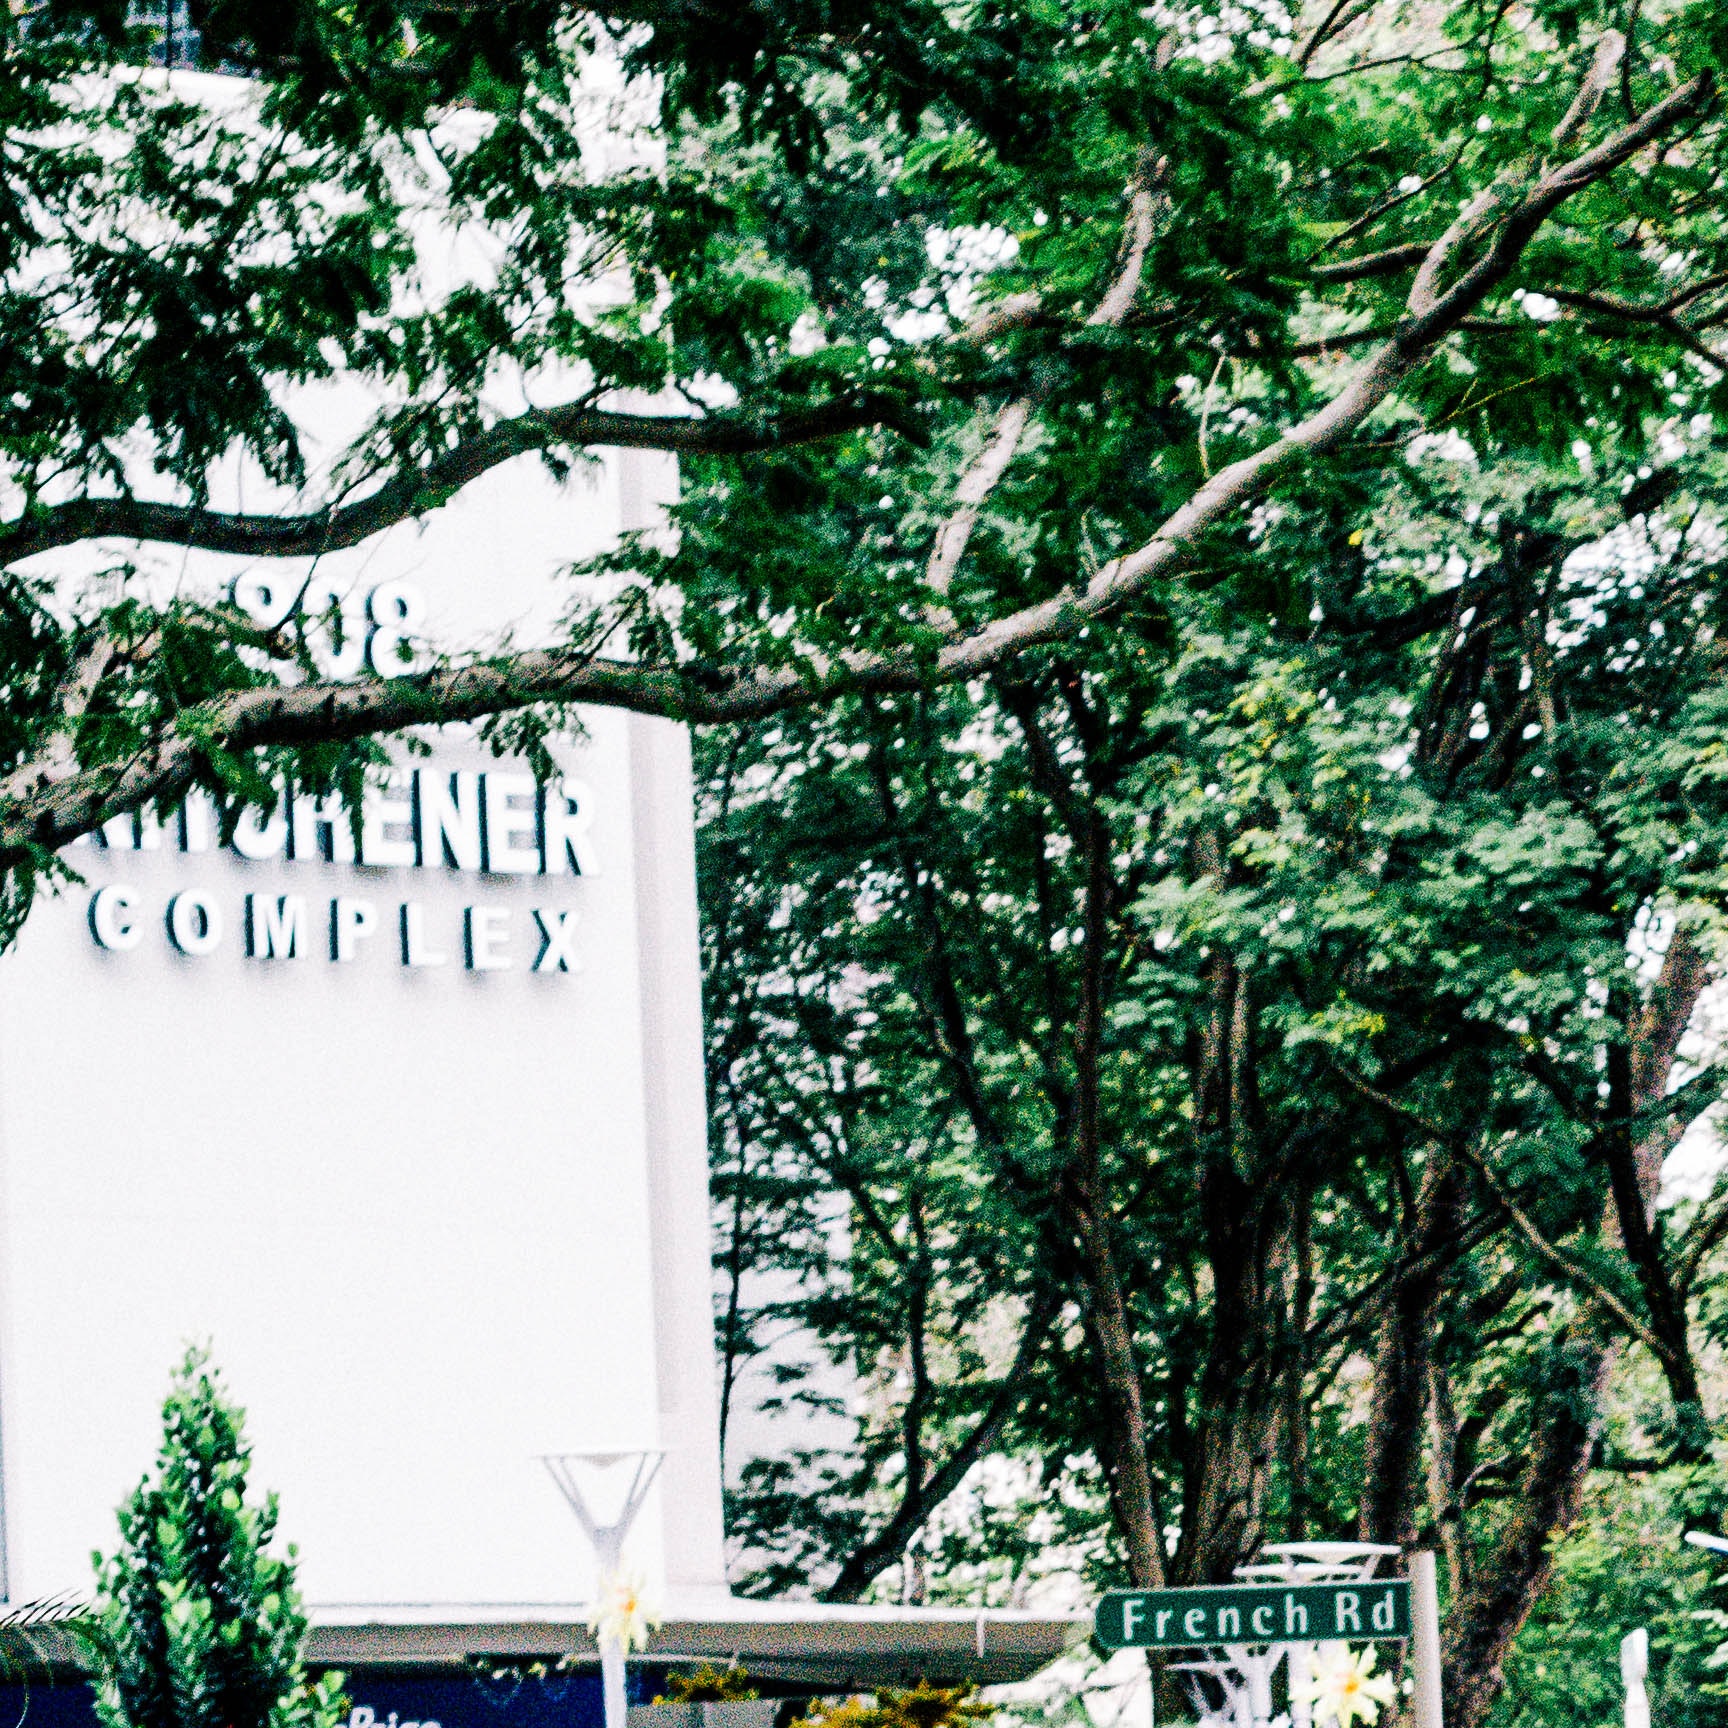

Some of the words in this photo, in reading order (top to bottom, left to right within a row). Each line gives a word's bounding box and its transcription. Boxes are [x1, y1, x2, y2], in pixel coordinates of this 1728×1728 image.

[88, 885, 583, 973] COMPLEX
[1121, 1592, 1310, 1641] French
[1333, 1589, 1397, 1633] Rd
